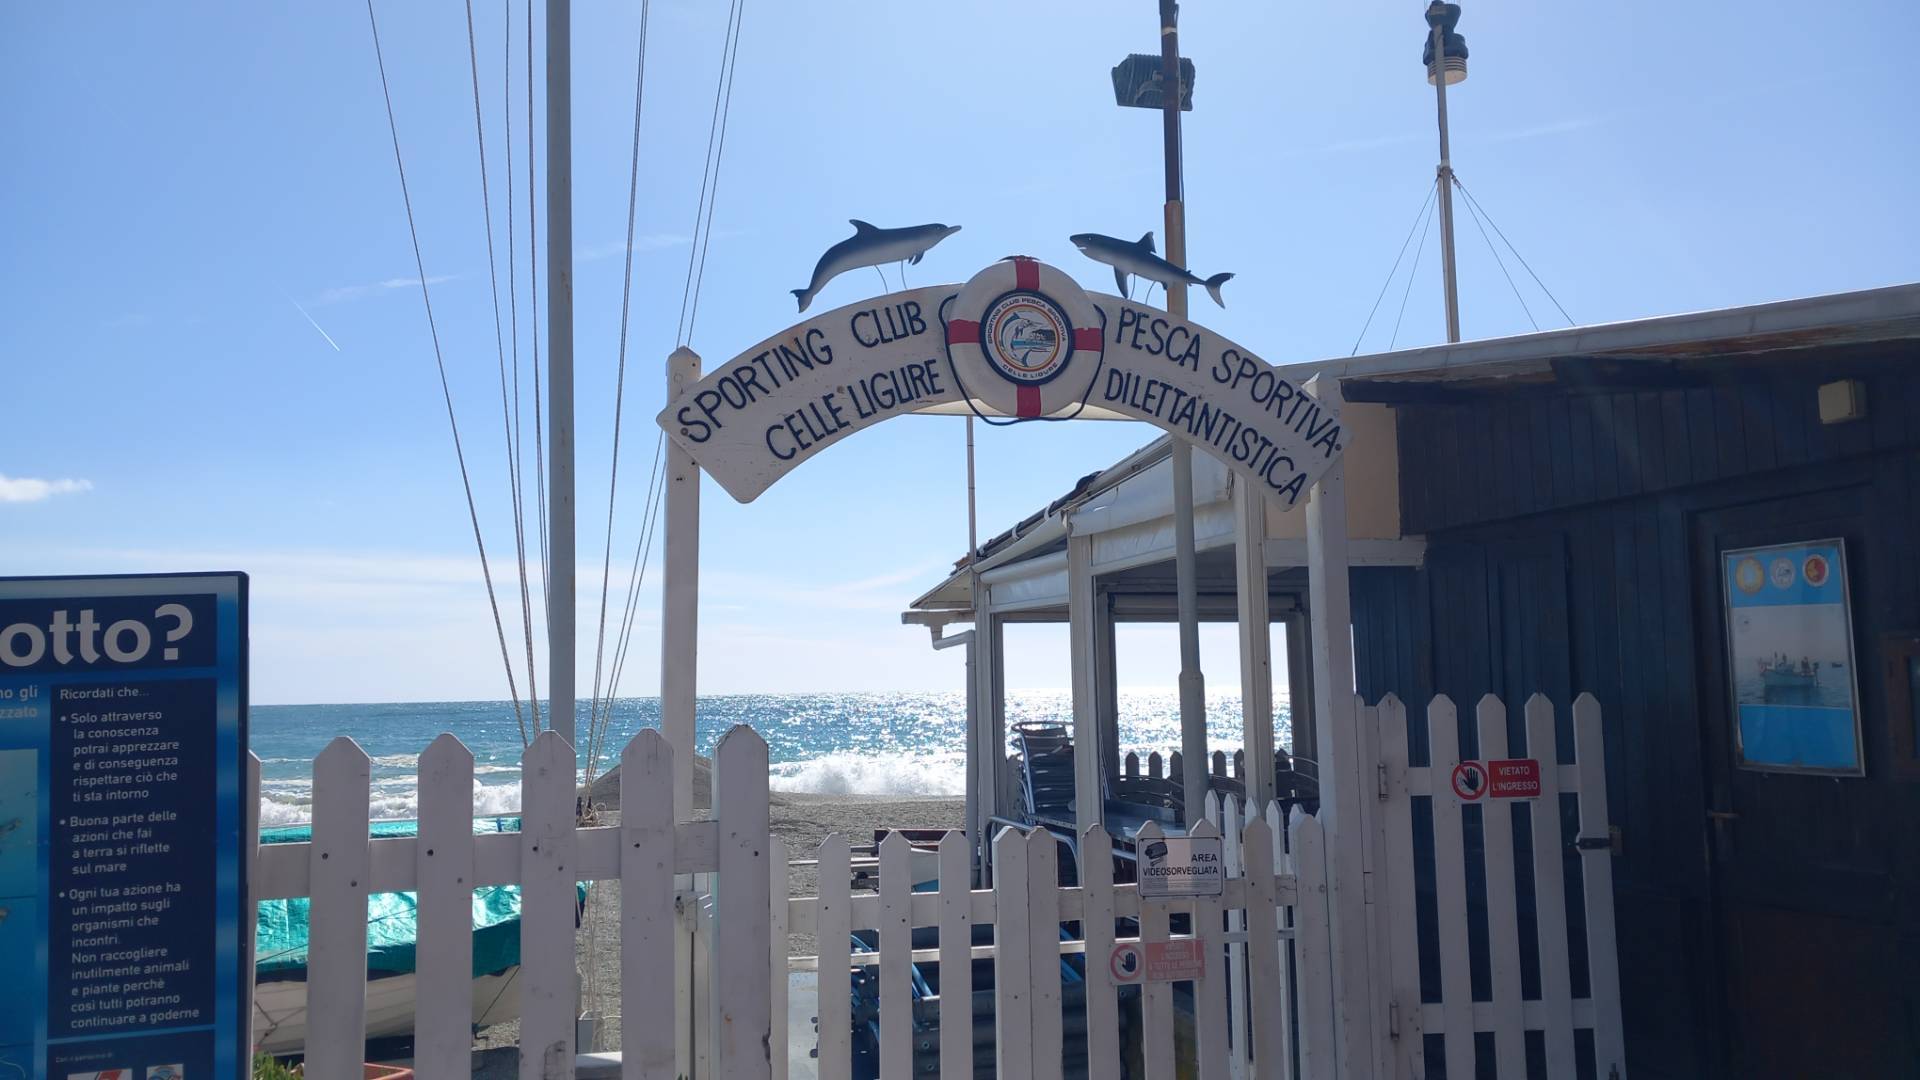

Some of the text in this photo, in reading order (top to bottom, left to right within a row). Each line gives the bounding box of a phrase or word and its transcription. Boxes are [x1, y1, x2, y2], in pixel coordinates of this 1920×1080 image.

[677, 301, 927, 443] SPORTING CLUB
[1115, 306, 1341, 458] PESCA SPORTIVA
[765, 358, 945, 460] CELLE LIGURE
[1103, 368, 1308, 505] DILETTANTISTICA
[0, 603, 193, 667] otto?
[19, 685, 38, 702] gli
[60, 688, 114, 700] Ricordati
[70, 711, 162, 723] Solo attraverso
[73, 727, 159, 739] la conoscenza
[73, 741, 180, 757] potrai apprezzare
[73, 757, 178, 771] e di conseguenza
[1499, 766, 1530, 776] VIETATO
[73, 771, 178, 788] rispettare ciò che
[1492, 781, 1538, 791] L'INGRESSO
[73, 789, 149, 802] ti sta intorno
[70, 810, 177, 827] Buona parte delle
[72, 828, 152, 843] azioni che fai
[72, 842, 170, 859] a terra si riflette
[1191, 853, 1218, 863] AREA
[72, 862, 127, 875] sul mare
[1143, 866, 1218, 876] VIDEOSORVEGLIATA
[69, 881, 181, 901] Ogni tua azione ha
[72, 898, 170, 916] un impatto sugli
[72, 916, 159, 933] organismi che
[72, 947, 168, 964] Non raccogliere
[72, 959, 190, 980] inutilmente animali
[71, 986, 79, 996] e
[82, 983, 120, 998] piante
[99, 998, 122, 1010] tutti
[126, 994, 181, 1010] potranno
[71, 1008, 200, 1029] continuare a goderne
